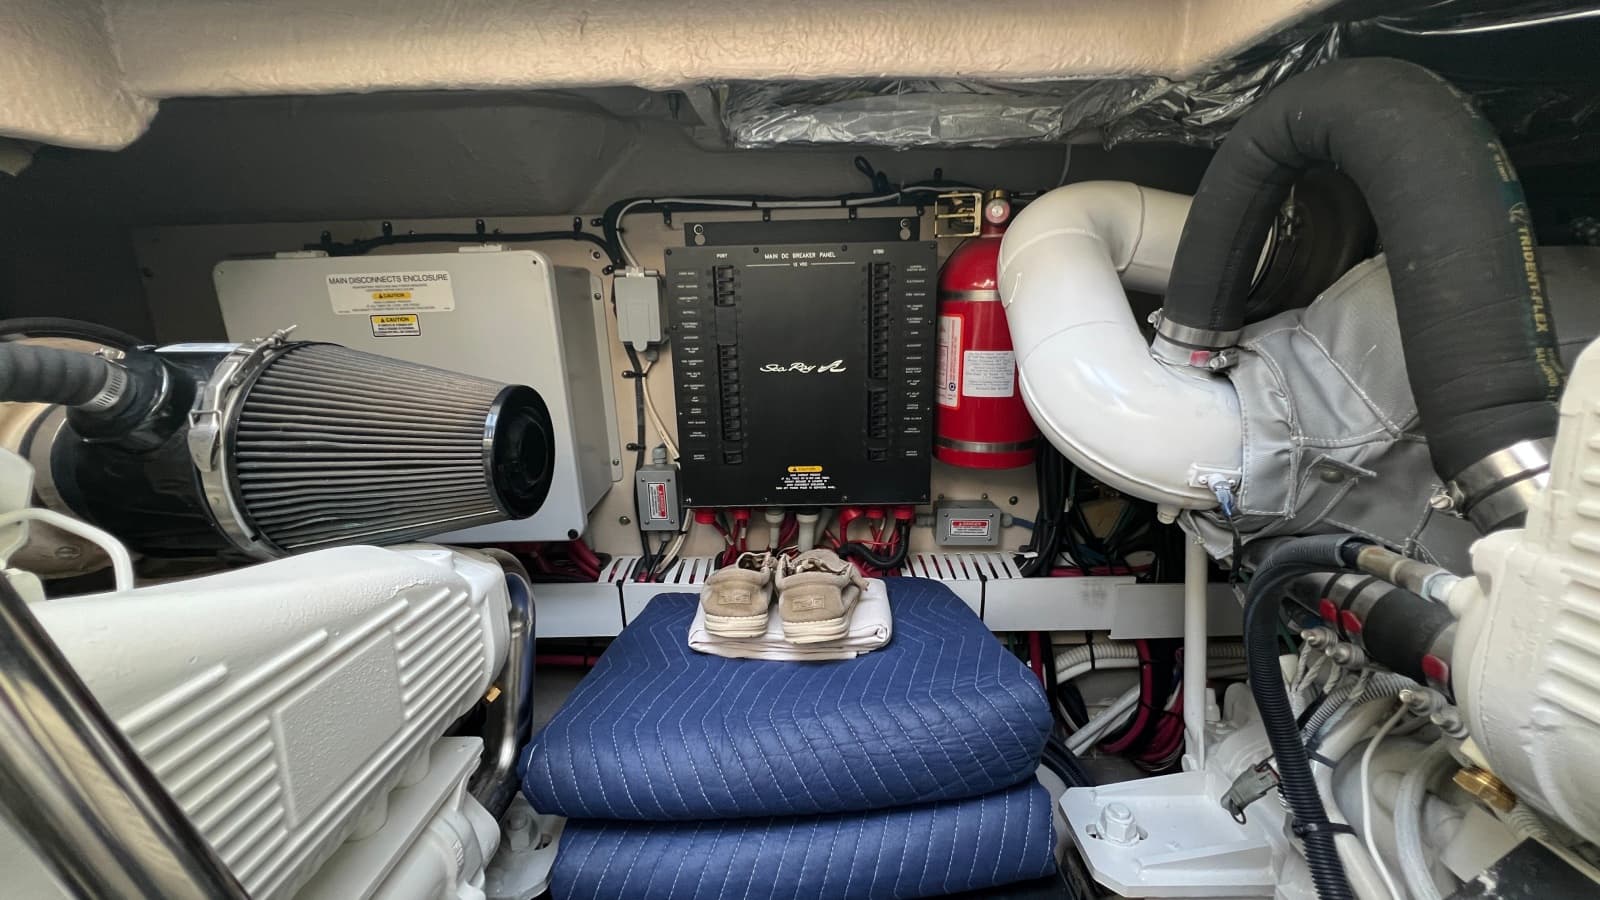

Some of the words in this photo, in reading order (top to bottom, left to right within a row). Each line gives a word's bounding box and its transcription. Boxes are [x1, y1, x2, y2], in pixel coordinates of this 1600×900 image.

[328, 277, 348, 285] MAIN
[349, 276, 401, 284] DISCONNECTS
[402, 273, 448, 281] ENCLOSURE
[1517, 226, 1549, 333] TRIDENT-FLEX
[760, 363, 787, 373] Sea
[788, 362, 817, 374] Ray
